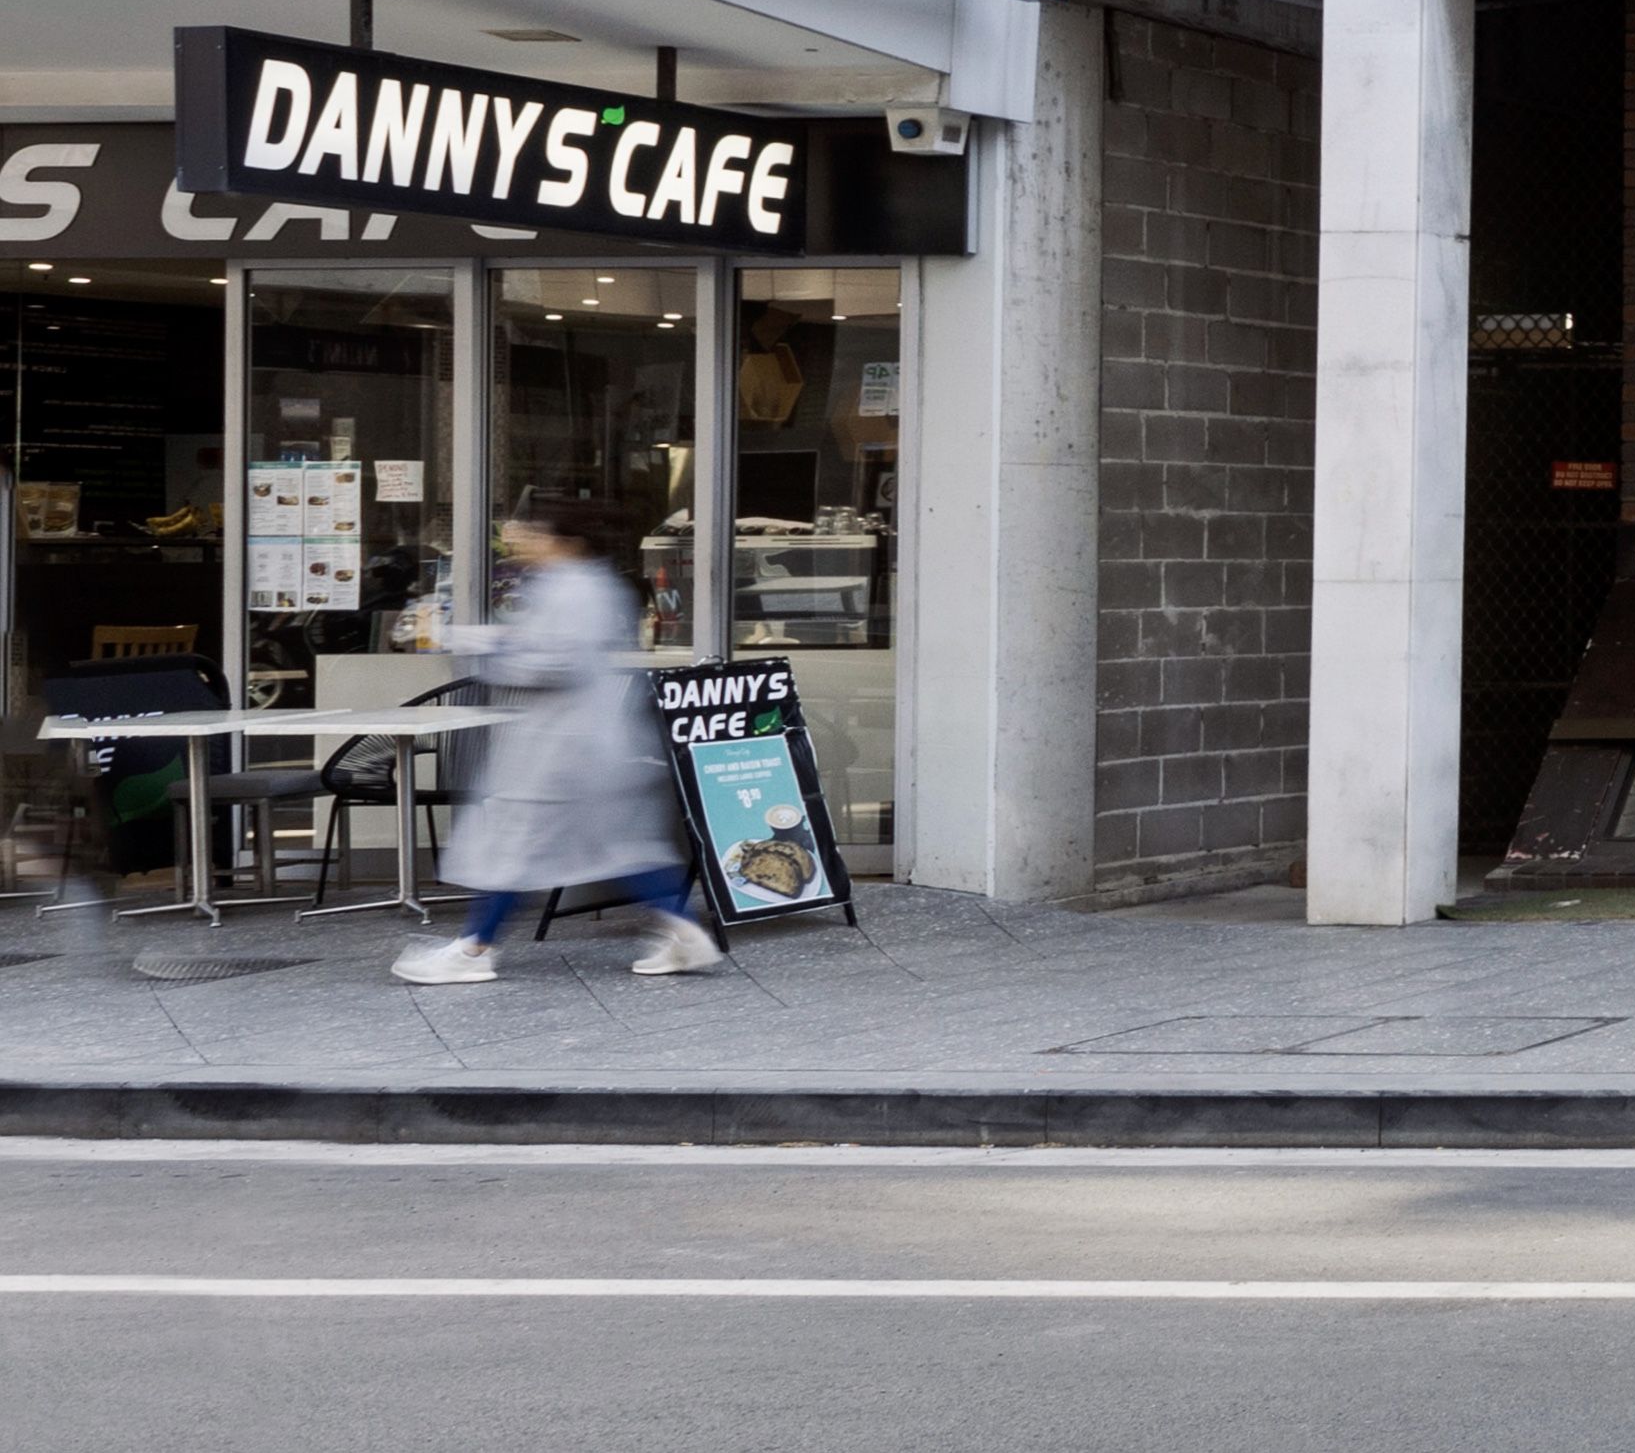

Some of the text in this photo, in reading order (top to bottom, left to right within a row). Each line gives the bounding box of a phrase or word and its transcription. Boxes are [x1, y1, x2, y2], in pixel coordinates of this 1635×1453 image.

[608, 120, 795, 235] CAFE
[663, 671, 789, 711] DANNYS
[671, 710, 747, 744] CAFE
